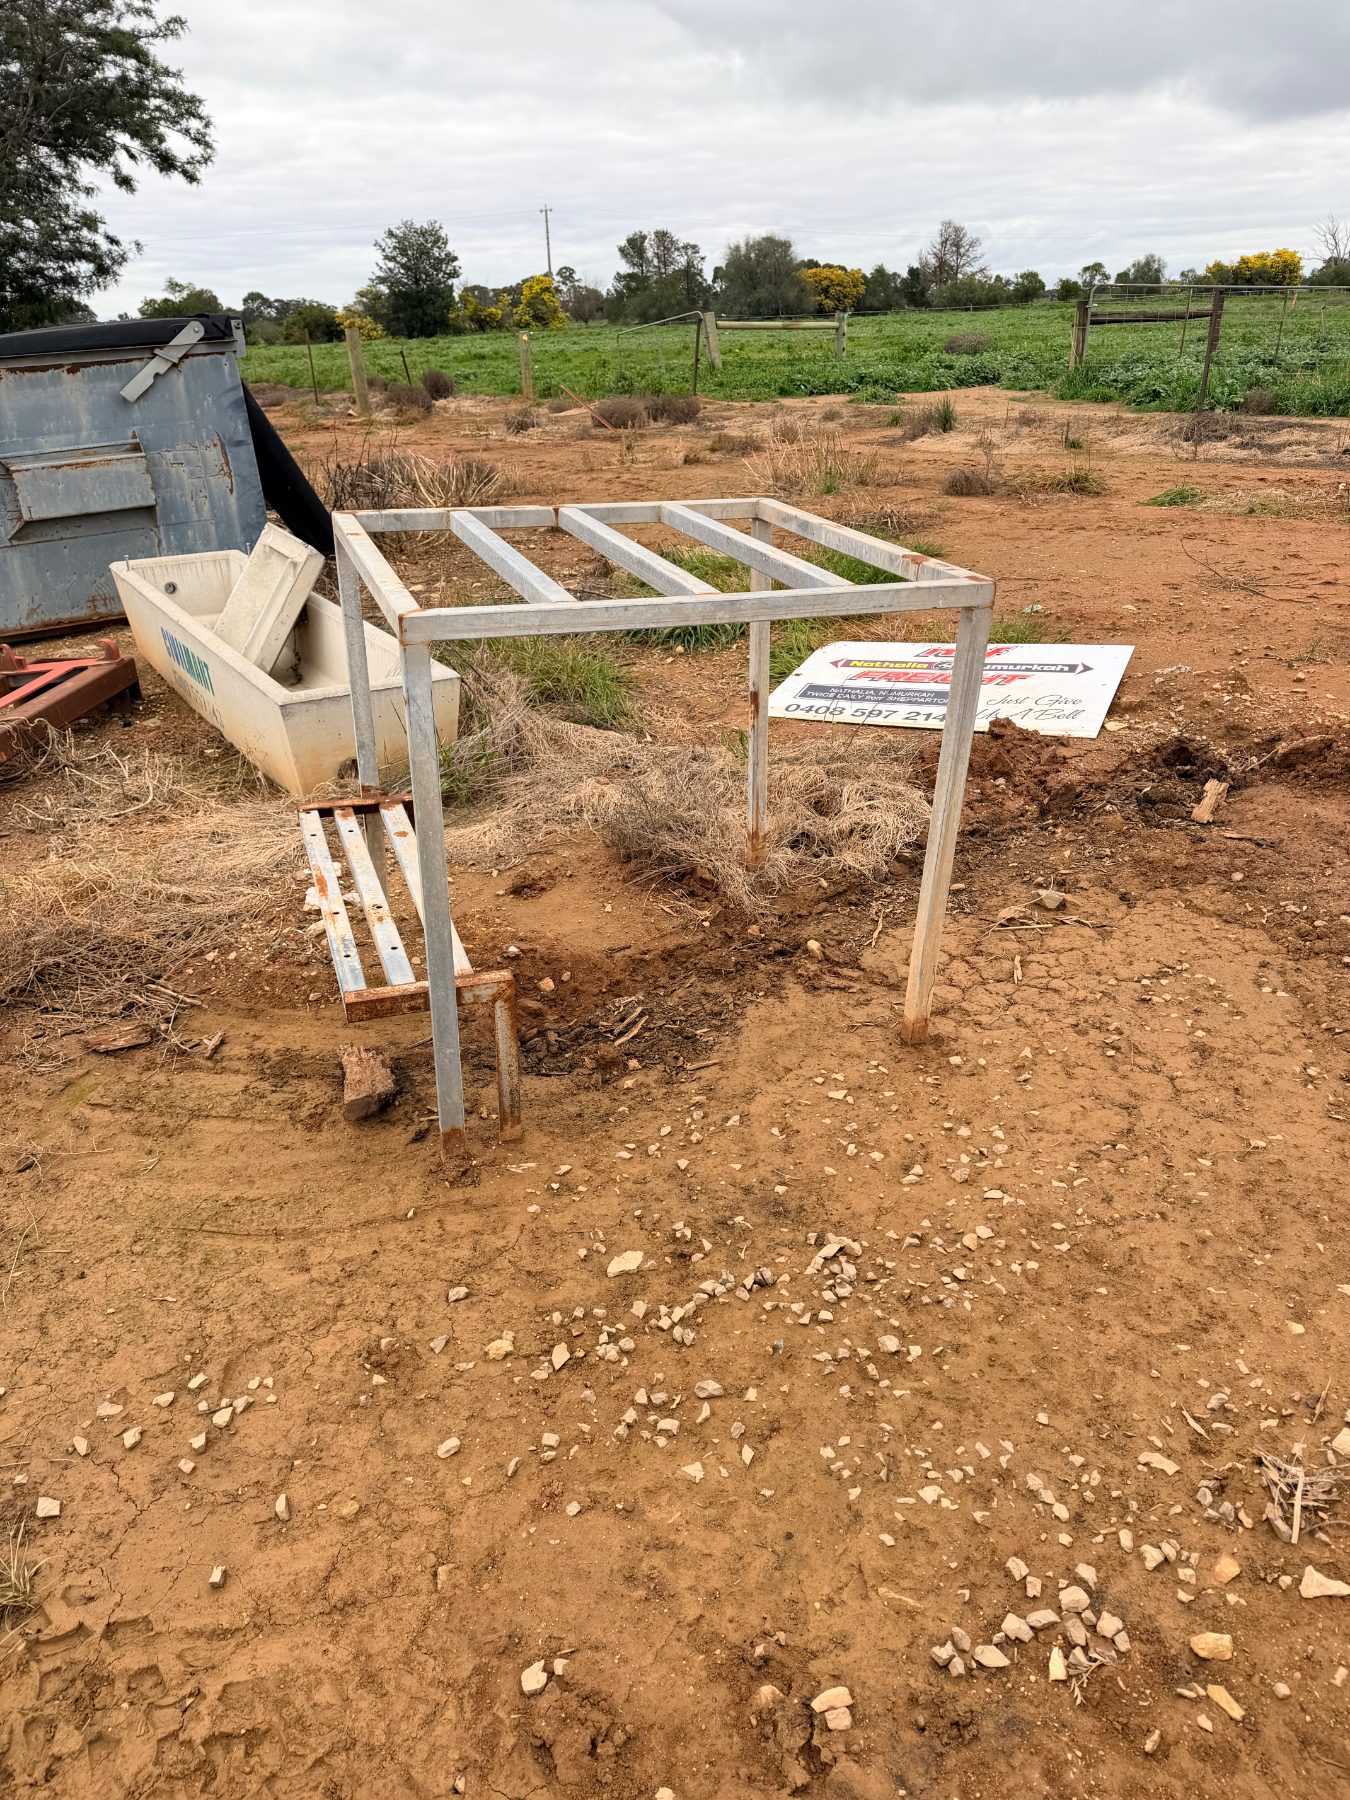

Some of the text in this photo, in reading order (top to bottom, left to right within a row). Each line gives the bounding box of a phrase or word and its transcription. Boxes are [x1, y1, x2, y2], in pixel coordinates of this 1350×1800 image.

[849, 660, 929, 669] Nathalia
[983, 664, 1070, 672] umurkah
[987, 694, 1083, 707] Just Give
[785, 703, 846, 716] 0408
[851, 708, 899, 719] 597
[1005, 708, 1034, 720] A
[1034, 708, 1086, 721] Bell
